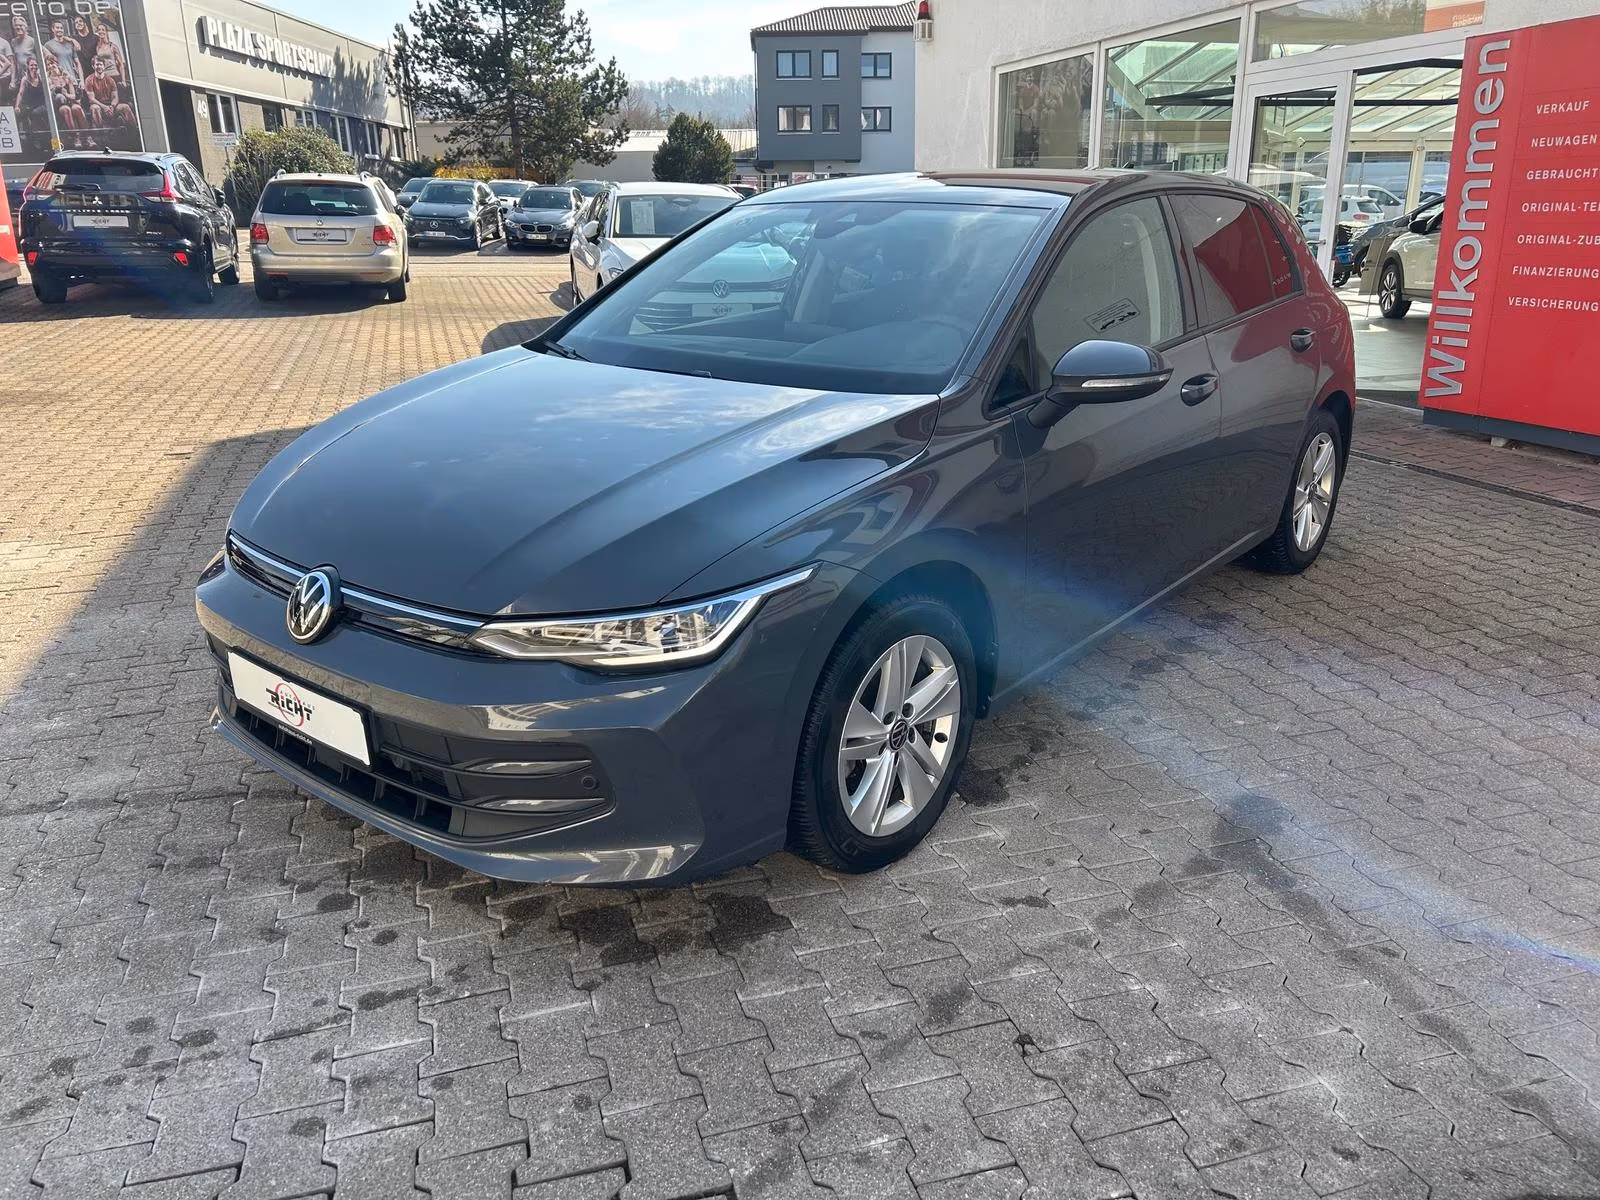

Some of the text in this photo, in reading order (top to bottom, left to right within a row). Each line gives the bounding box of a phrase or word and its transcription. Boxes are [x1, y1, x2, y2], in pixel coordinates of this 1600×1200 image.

[37, 1, 65, 16] to
[74, 0, 111, 15] be
[206, 16, 337, 79] PLAZA SPORTSCLUB
[197, 99, 208, 118] 49
[1536, 100, 1591, 115] VERKAUF
[1531, 134, 1598, 148] NEUWAGEN
[1424, 38, 1512, 398] Willkommen
[1517, 235, 1600, 246] ORIGINAL-ZUB
[1512, 265, 1600, 279] FINANZIERUNG
[1508, 296, 1600, 312] VERSICHERUNG
